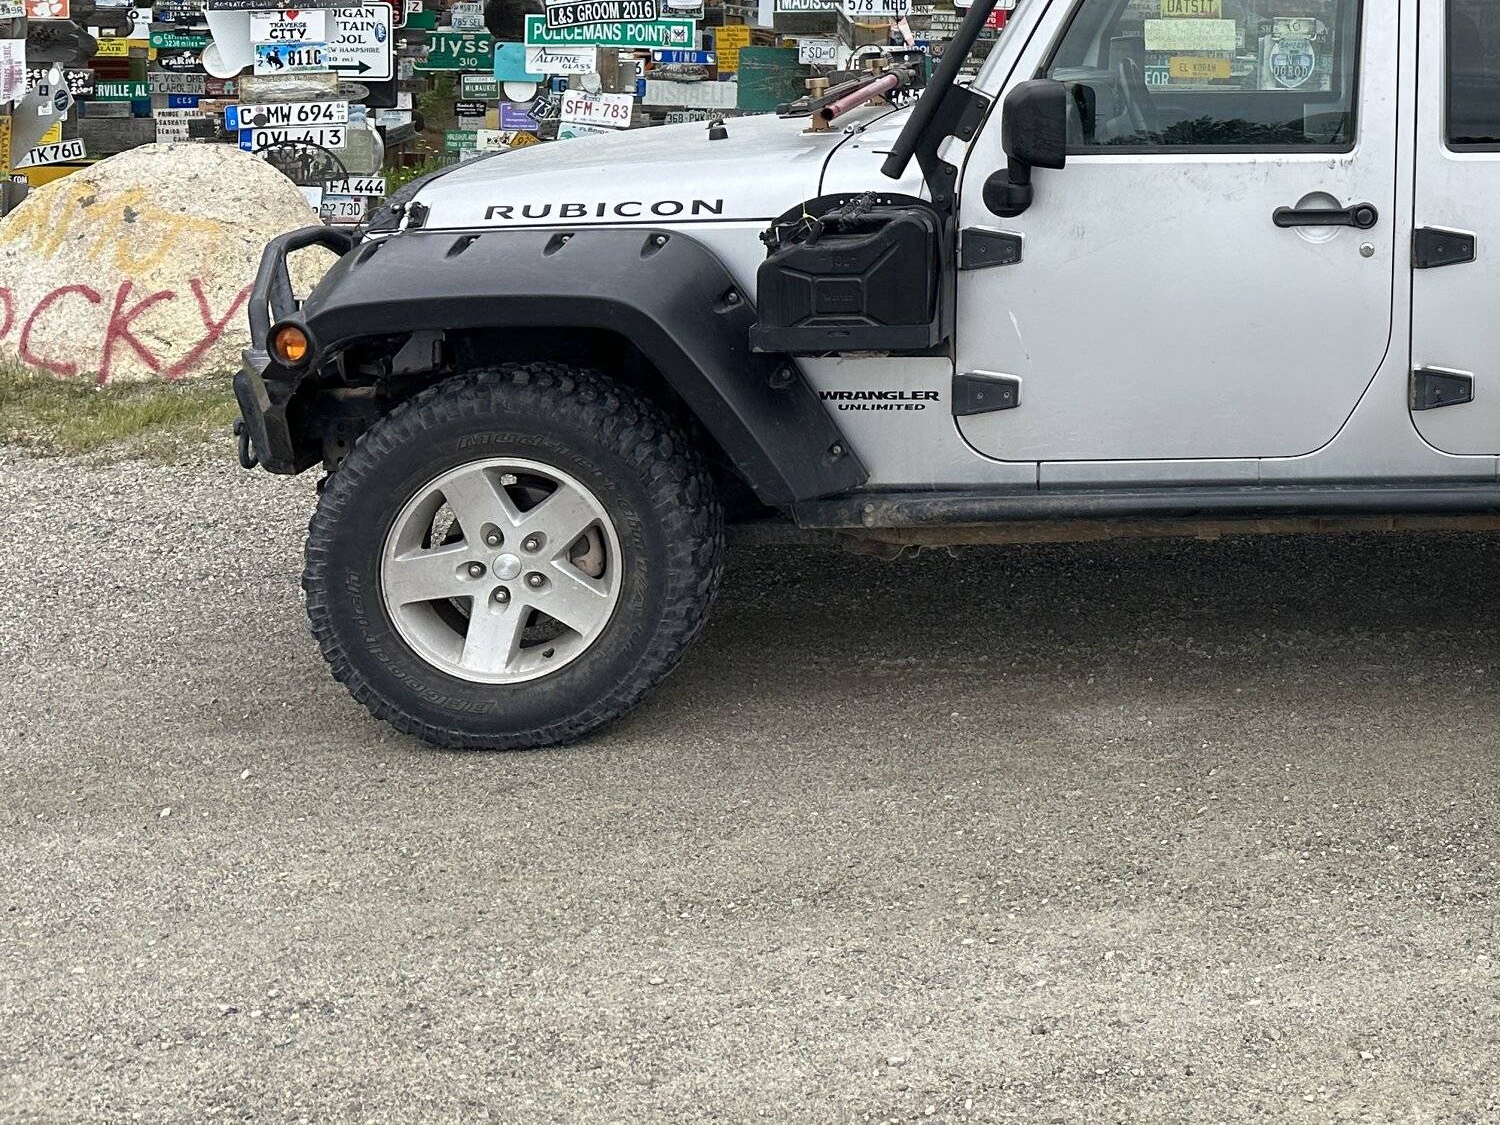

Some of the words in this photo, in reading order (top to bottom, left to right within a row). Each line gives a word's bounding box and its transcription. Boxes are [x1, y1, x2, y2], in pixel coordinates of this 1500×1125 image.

[550, 9, 574, 24] L&S
[577, 4, 621, 21] GROOM
[623, 1, 652, 17] 2016
[269, 29, 307, 41] CITY
[266, 106, 291, 124] MW
[298, 104, 334, 121] 694
[484, 198, 724, 221] RUBICON
[818, 389, 940, 402] WRANGLER
[837, 403, 925, 411] UNLIMITED
